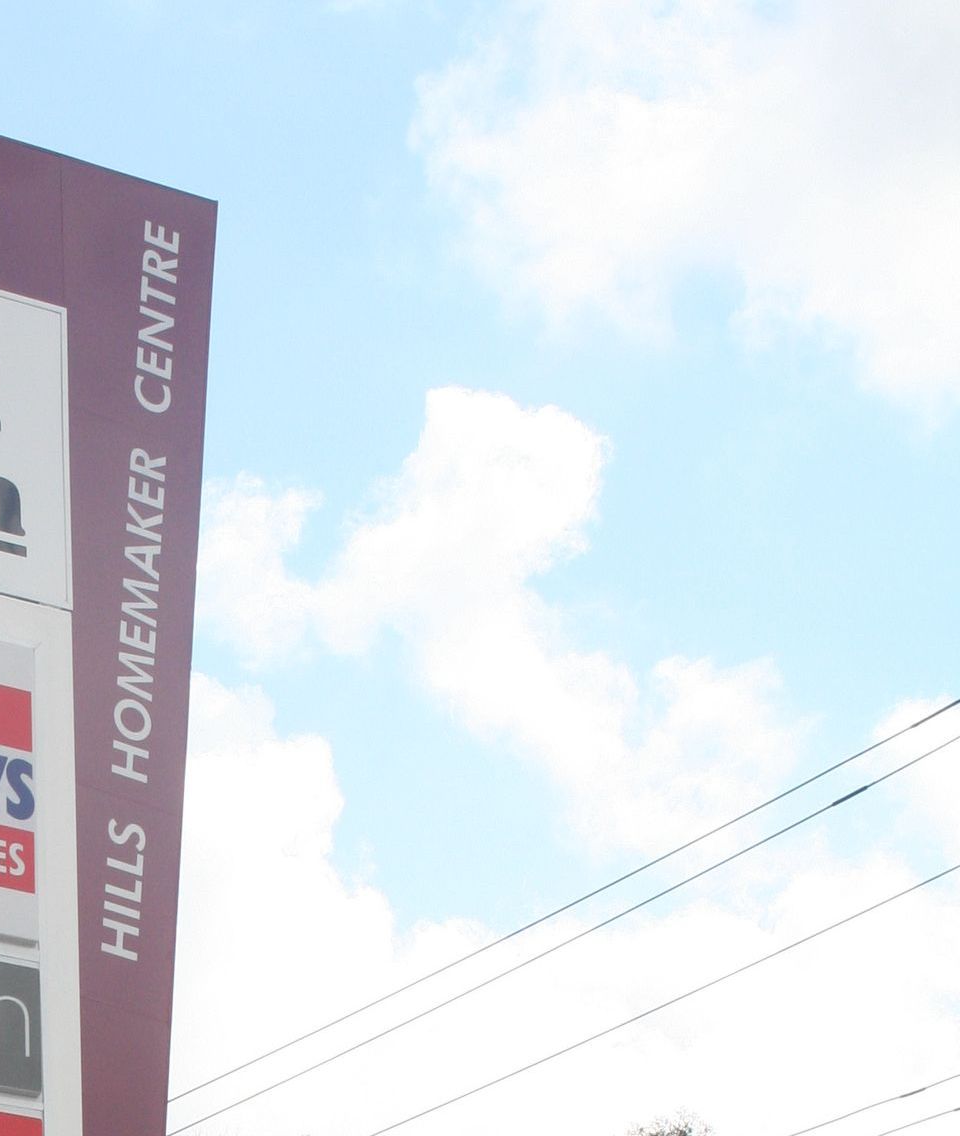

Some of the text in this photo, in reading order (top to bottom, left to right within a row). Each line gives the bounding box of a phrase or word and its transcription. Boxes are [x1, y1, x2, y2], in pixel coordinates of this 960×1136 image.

[101, 220, 181, 961] HILLS HOMEMAKER CENTRE
